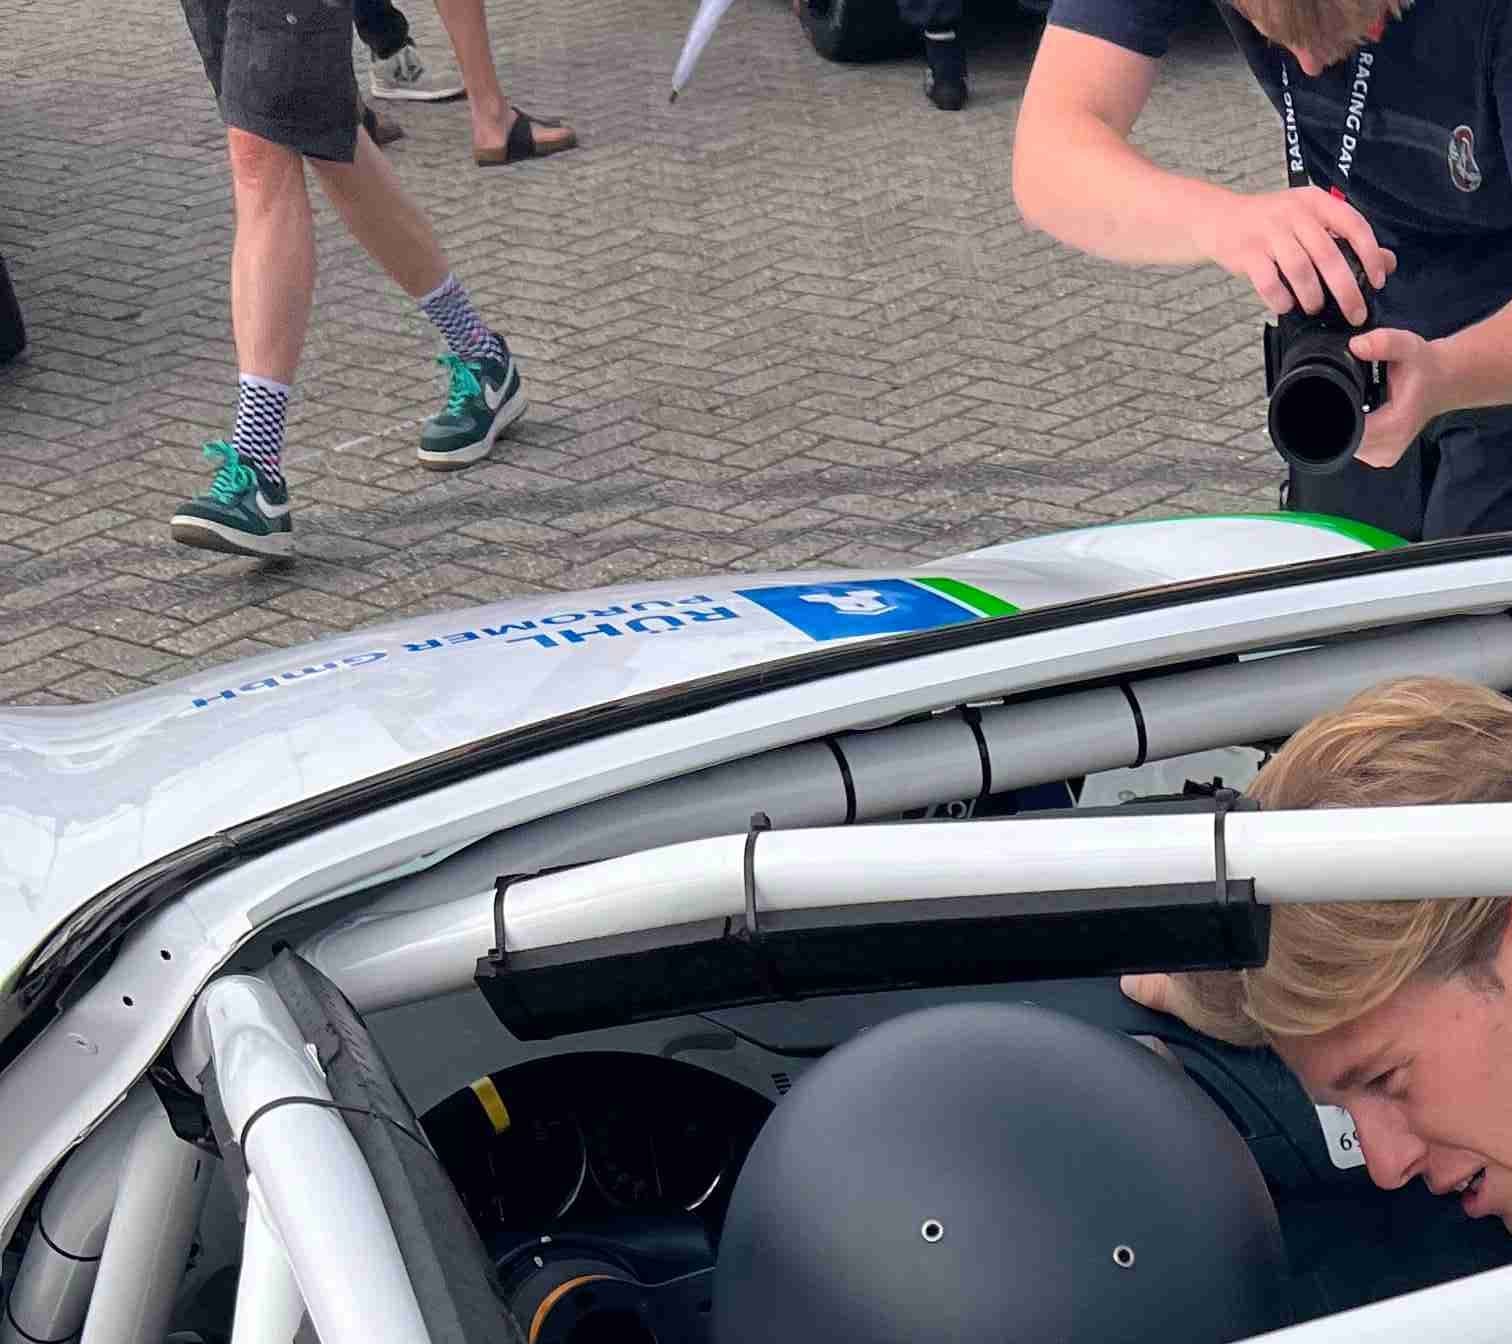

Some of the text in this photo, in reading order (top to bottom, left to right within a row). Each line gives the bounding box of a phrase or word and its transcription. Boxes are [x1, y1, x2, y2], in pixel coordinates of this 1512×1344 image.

[1282, 91, 1305, 173] RACING
[1337, 52, 1375, 178] RACING DAY
[191, 595, 712, 708] PUROMER GmbH
[506, 606, 740, 648] RÜHL
